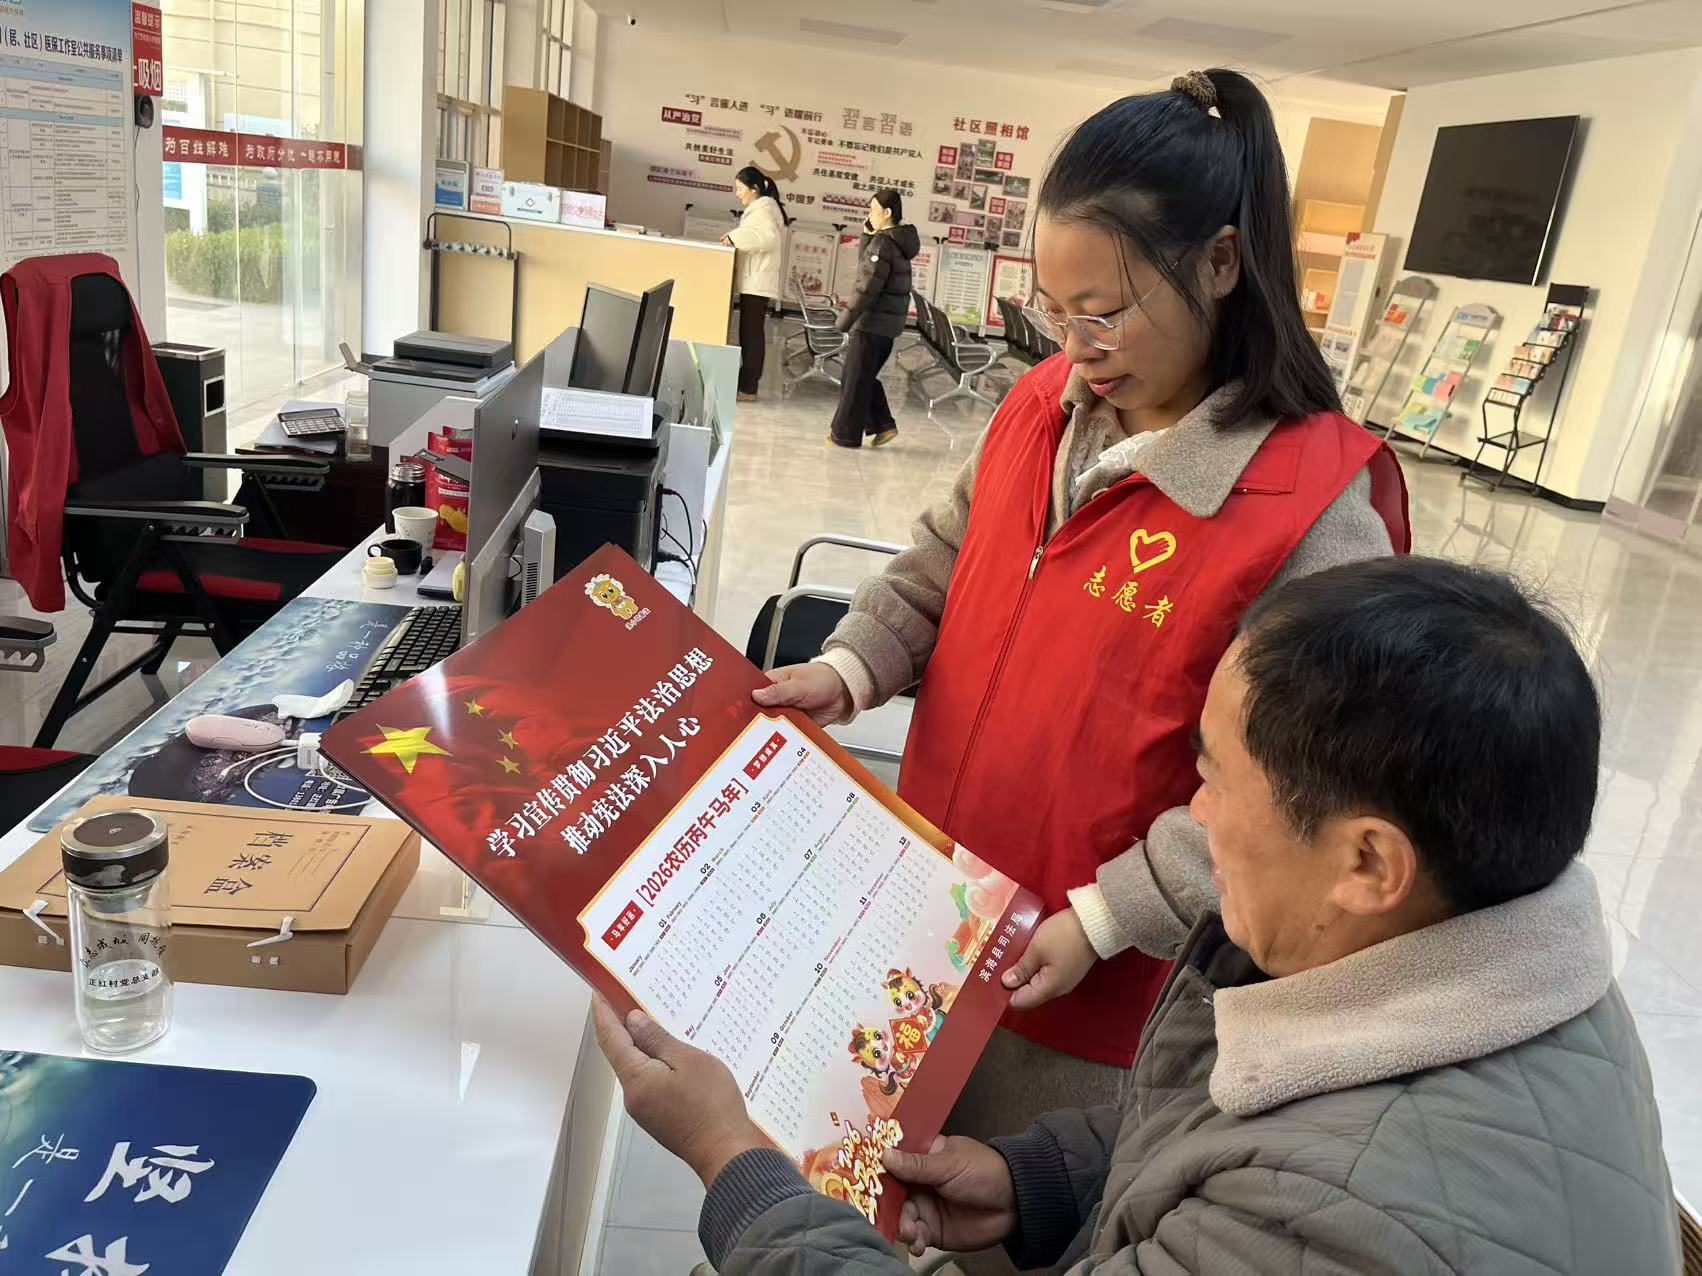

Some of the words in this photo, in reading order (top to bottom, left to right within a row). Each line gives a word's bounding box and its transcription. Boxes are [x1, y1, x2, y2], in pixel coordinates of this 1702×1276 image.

[953, 117, 1030, 141] 社区照相馆
[785, 192, 815, 205] 中国梦
[1083, 564, 1174, 628] 志愿者
[485, 647, 714, 858] 学习宣传贯彻习近平法治思想
[796, 746, 807, 757] 04
[559, 714, 702, 856] 推动宪法深入人心
[846, 792, 856, 803] 08
[751, 801, 761, 813] 03
[899, 836, 907, 846] 12
[804, 849, 813, 860] 07
[203, 829, 294, 896] 档案盒
[700, 863, 711, 874] 02
[859, 896, 867, 905] 11
[658, 919, 667, 928] 01
[756, 912, 766, 924] 06
[979, 910, 1023, 982] 滨海县司法局
[814, 962, 824, 975] 10
[88, 968, 160, 988] 正红村党总支部
[714, 976, 723, 987] 05
[770, 1032, 780, 1044] 09
[896, 1021, 923, 1050] 福
